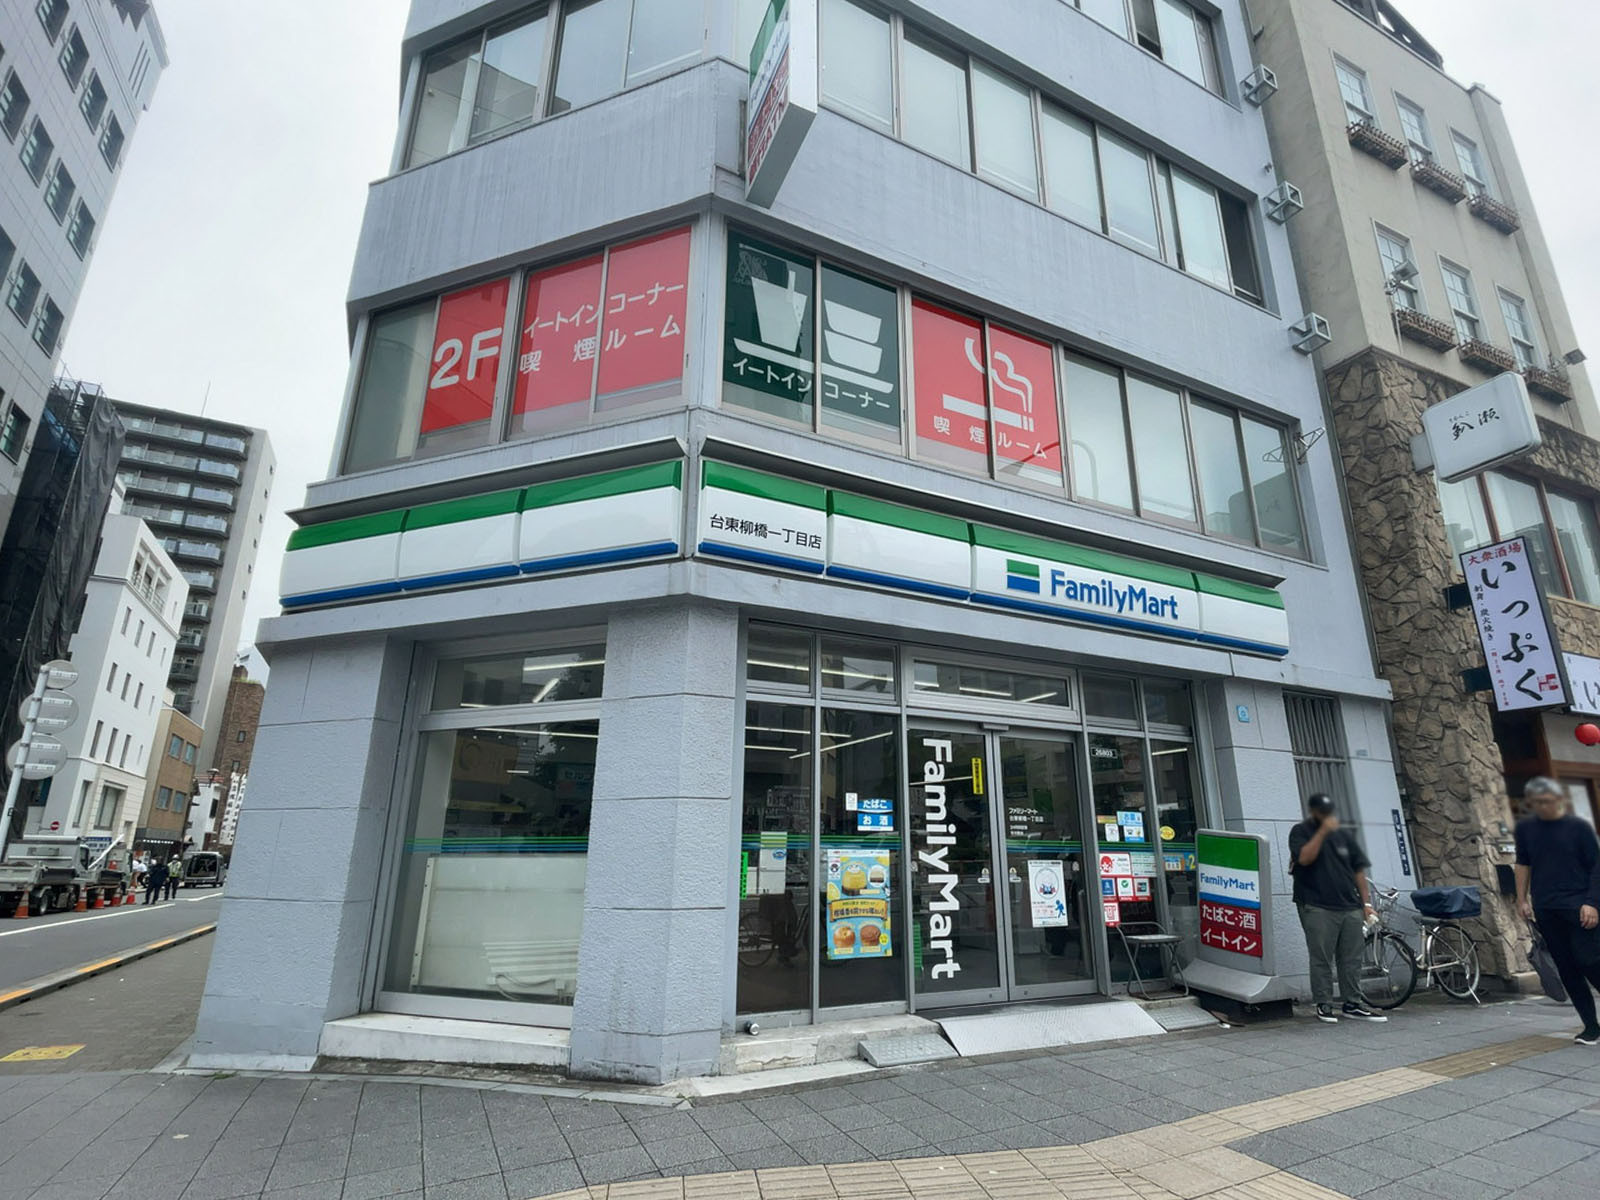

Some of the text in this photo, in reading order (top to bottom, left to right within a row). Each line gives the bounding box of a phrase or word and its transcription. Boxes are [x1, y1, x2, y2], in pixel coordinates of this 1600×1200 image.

[524, 283, 684, 338] イートインコーナー
[430, 328, 502, 390] 2F
[520, 315, 681, 375] 喫煙ルーム
[732, 358, 891, 410] イートインコーナー
[933, 415, 1047, 459] 喫煙ルーム
[709, 513, 823, 550] 台東柳橋一丁目店
[1051, 569, 1179, 620] FamilyMart
[1481, 561, 1543, 701] いっぷく
[863, 799, 888, 809] たばこ
[863, 814, 888, 826] お酒
[918, 738, 961, 980] FamilyMart
[1200, 873, 1255, 892] FamilyMart
[1202, 904, 1256, 930] たばこ・酒
[1203, 928, 1257, 952] イートイン
